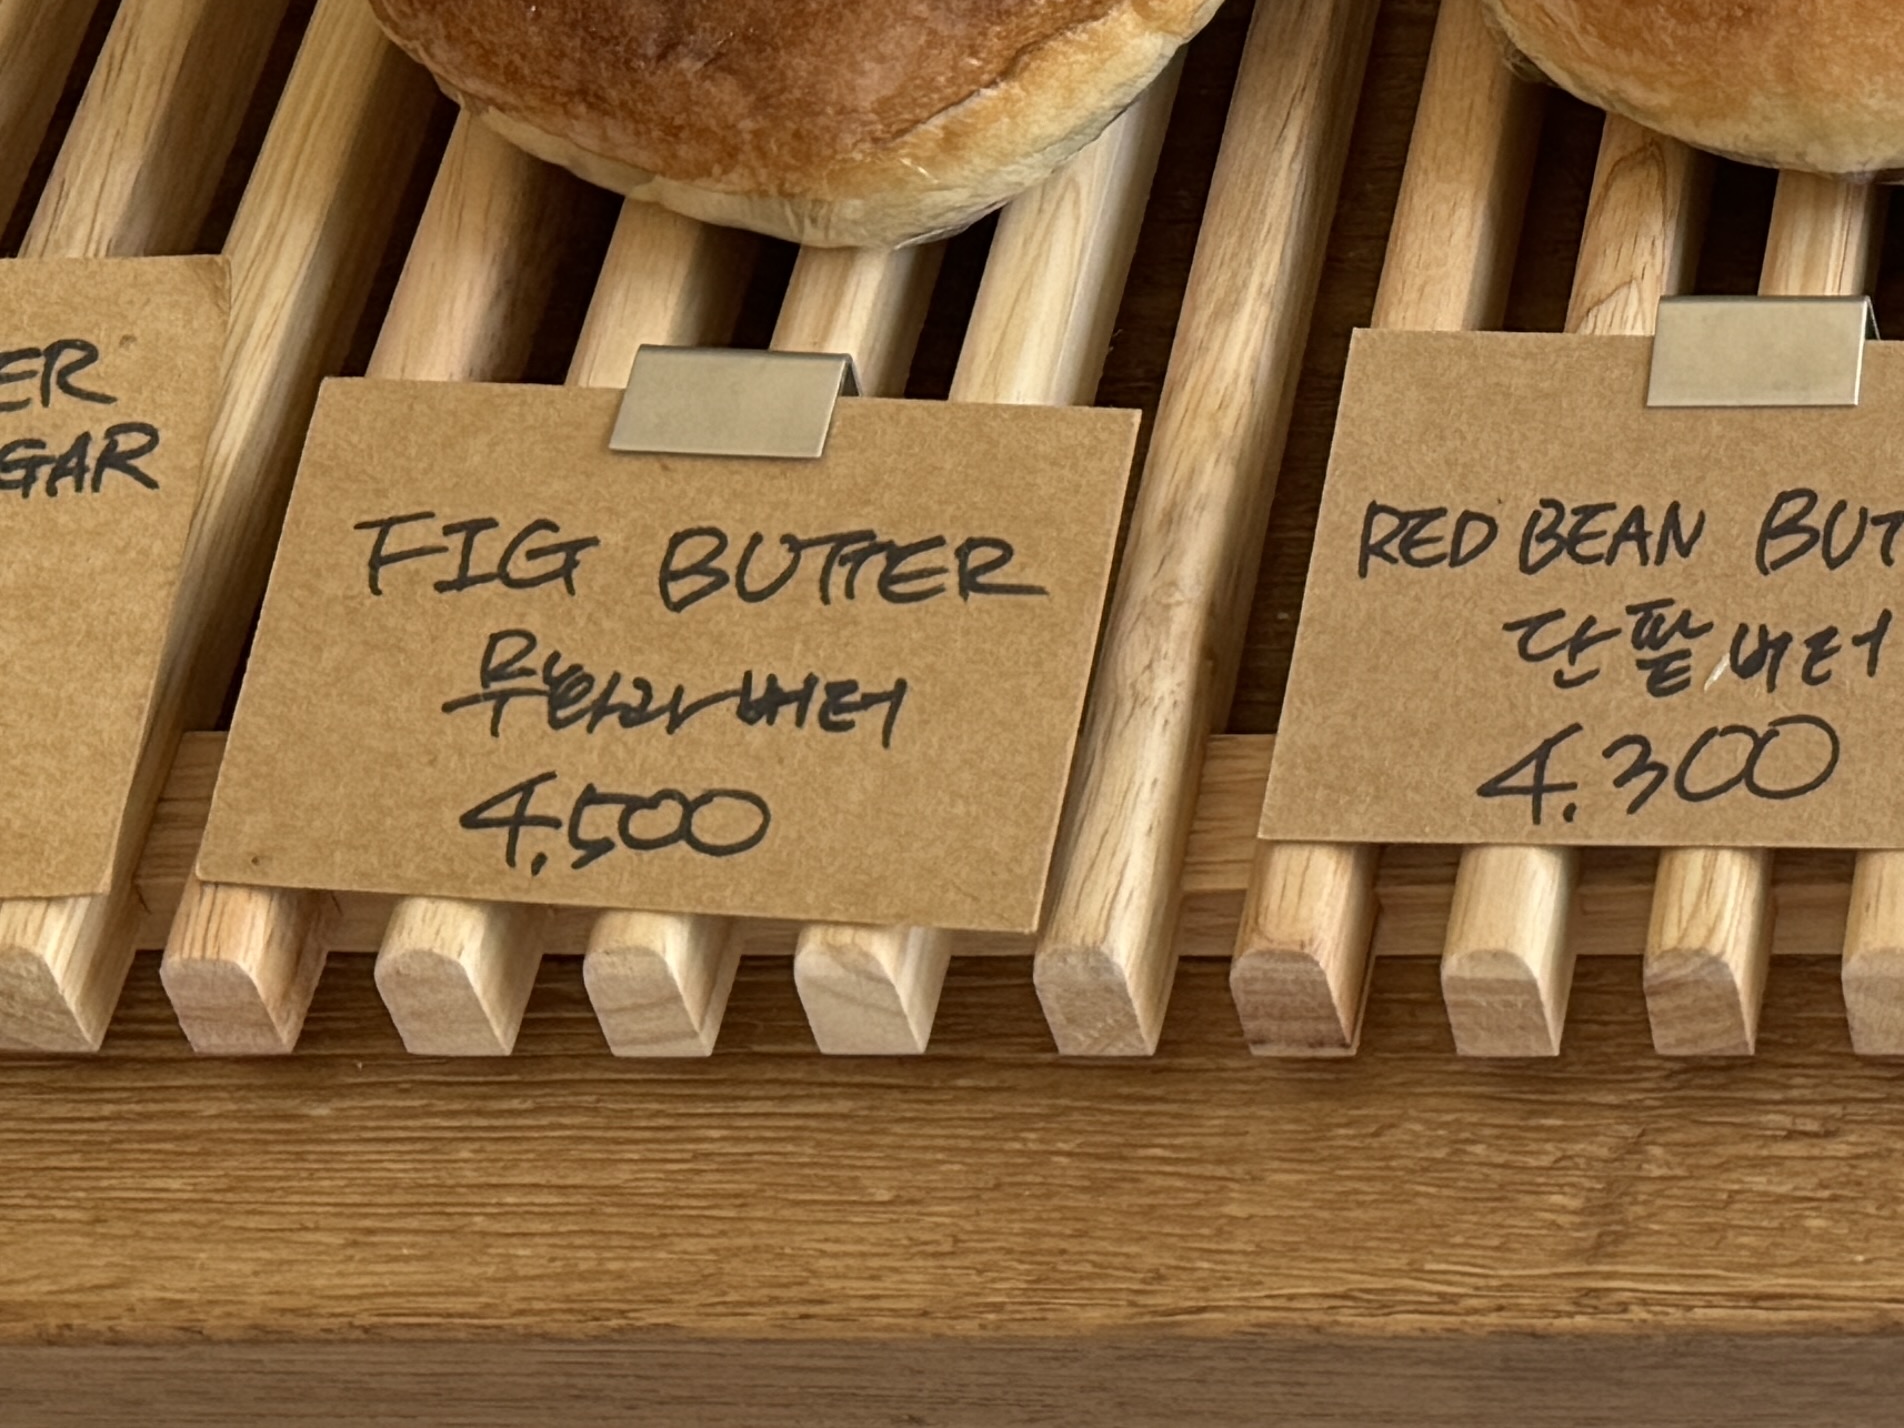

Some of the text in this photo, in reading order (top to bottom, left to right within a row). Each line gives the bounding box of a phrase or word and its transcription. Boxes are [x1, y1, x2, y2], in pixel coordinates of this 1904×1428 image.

[352, 511, 1050, 615] FIG BUTTER
[1356, 498, 1500, 580] RED
[1517, 496, 1708, 577] BEAN
